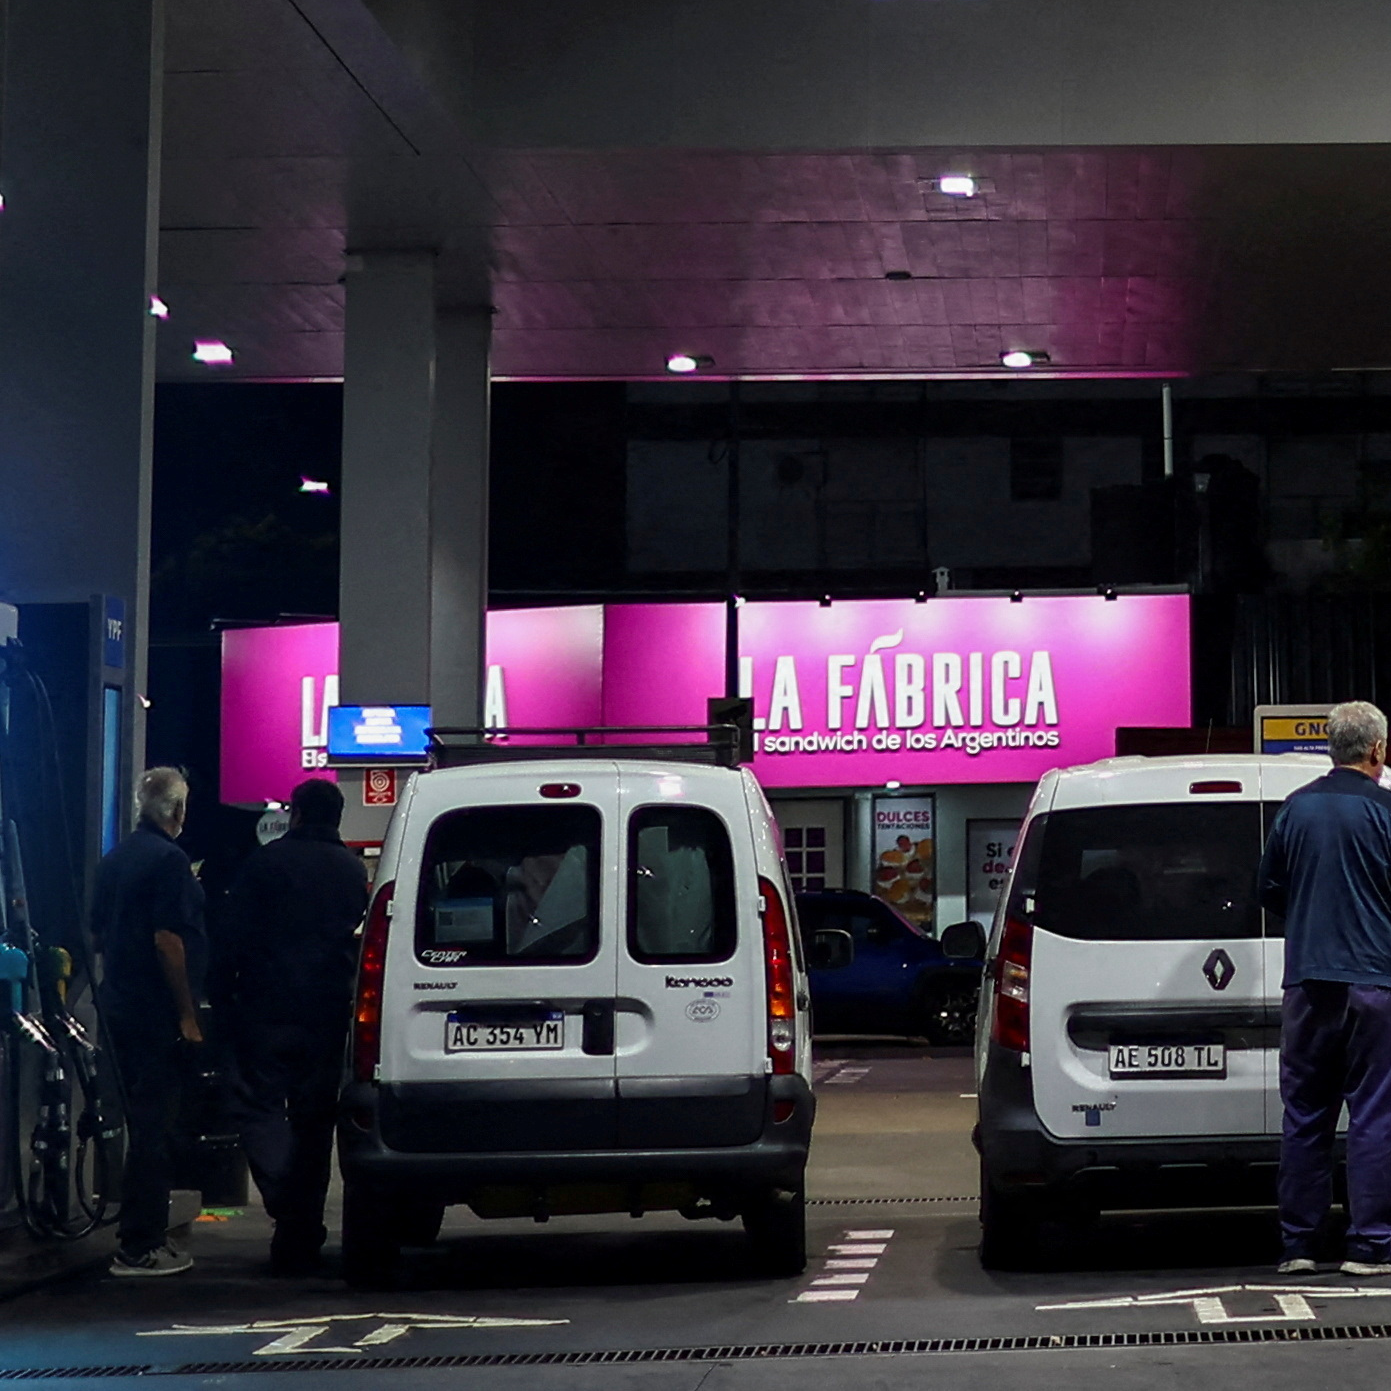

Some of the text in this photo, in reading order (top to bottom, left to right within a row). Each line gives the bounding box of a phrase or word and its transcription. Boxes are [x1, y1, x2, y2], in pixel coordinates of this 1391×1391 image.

[739, 628, 1059, 730] LA FÁBRICA
[763, 730, 867, 753] sandwich
[872, 729, 901, 750] de
[906, 729, 937, 749] los
[940, 727, 1060, 755] Argentinos
[876, 811, 930, 823] DULCES
[986, 842, 1003, 857] Si
[413, 981, 459, 990] RENAULT
[453, 1023, 558, 1046] AC 354 YM
[1114, 1045, 1219, 1069] AE 508 TL
